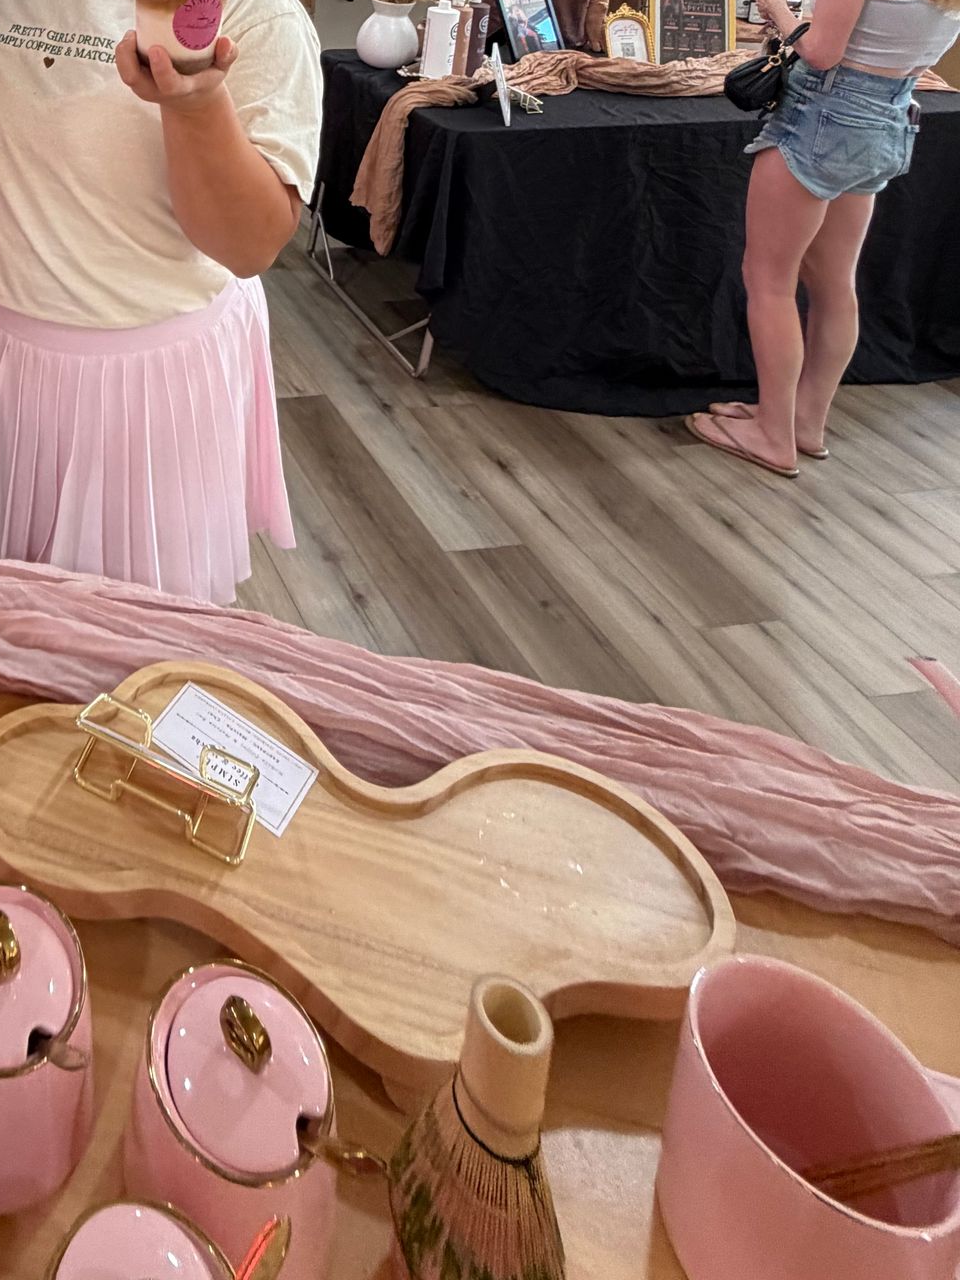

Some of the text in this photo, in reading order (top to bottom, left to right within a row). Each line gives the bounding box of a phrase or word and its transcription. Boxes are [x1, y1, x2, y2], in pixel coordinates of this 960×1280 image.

[8, 24, 116, 50] PRETTY GIRLS DRINK
[25, 39, 64, 56] COFFEE
[64, 46, 73, 57] &
[73, 47, 116, 64] MATCH
[205, 758, 241, 787] SIMPL
